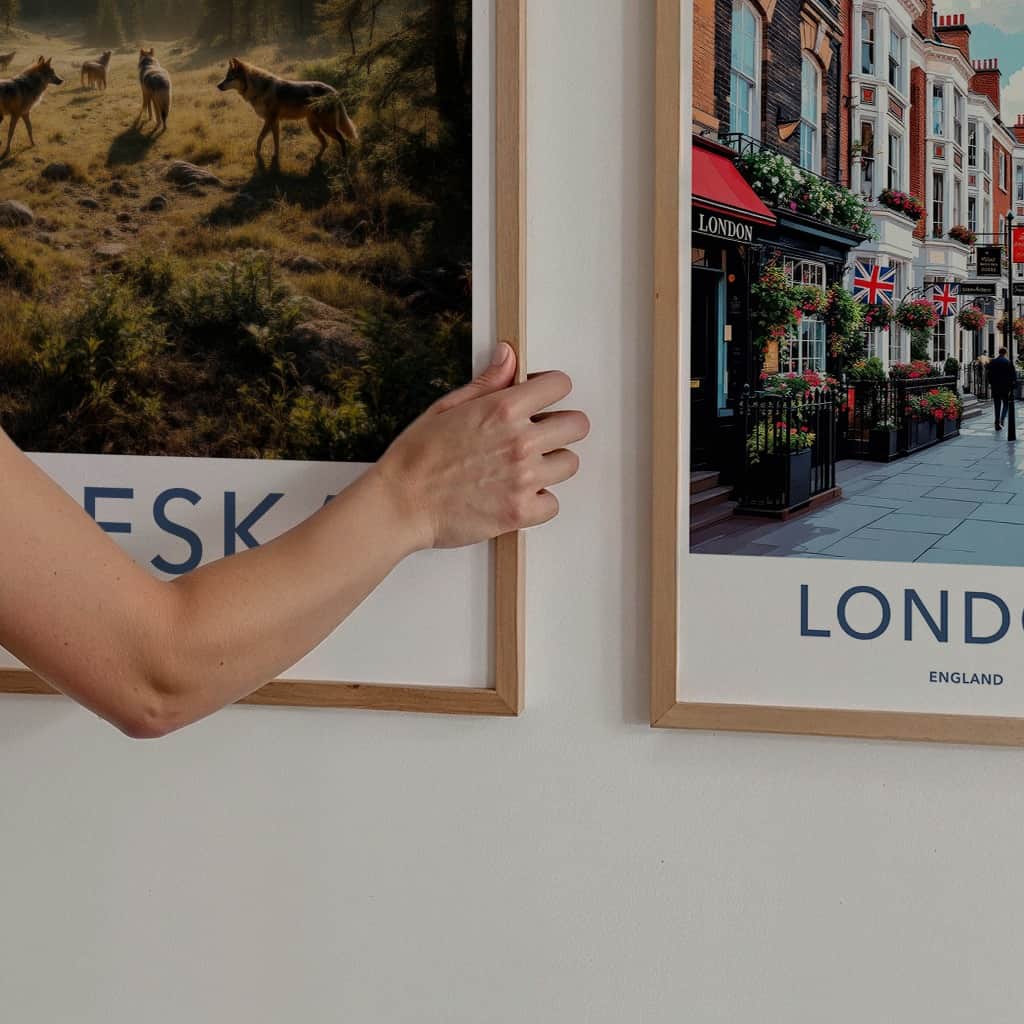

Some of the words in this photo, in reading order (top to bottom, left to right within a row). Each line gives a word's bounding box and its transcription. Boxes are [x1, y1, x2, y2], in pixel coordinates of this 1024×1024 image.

[698, 213, 753, 242] LONDON
[800, 584, 1024, 645] LOND
[929, 671, 1004, 686] ENGLAND
